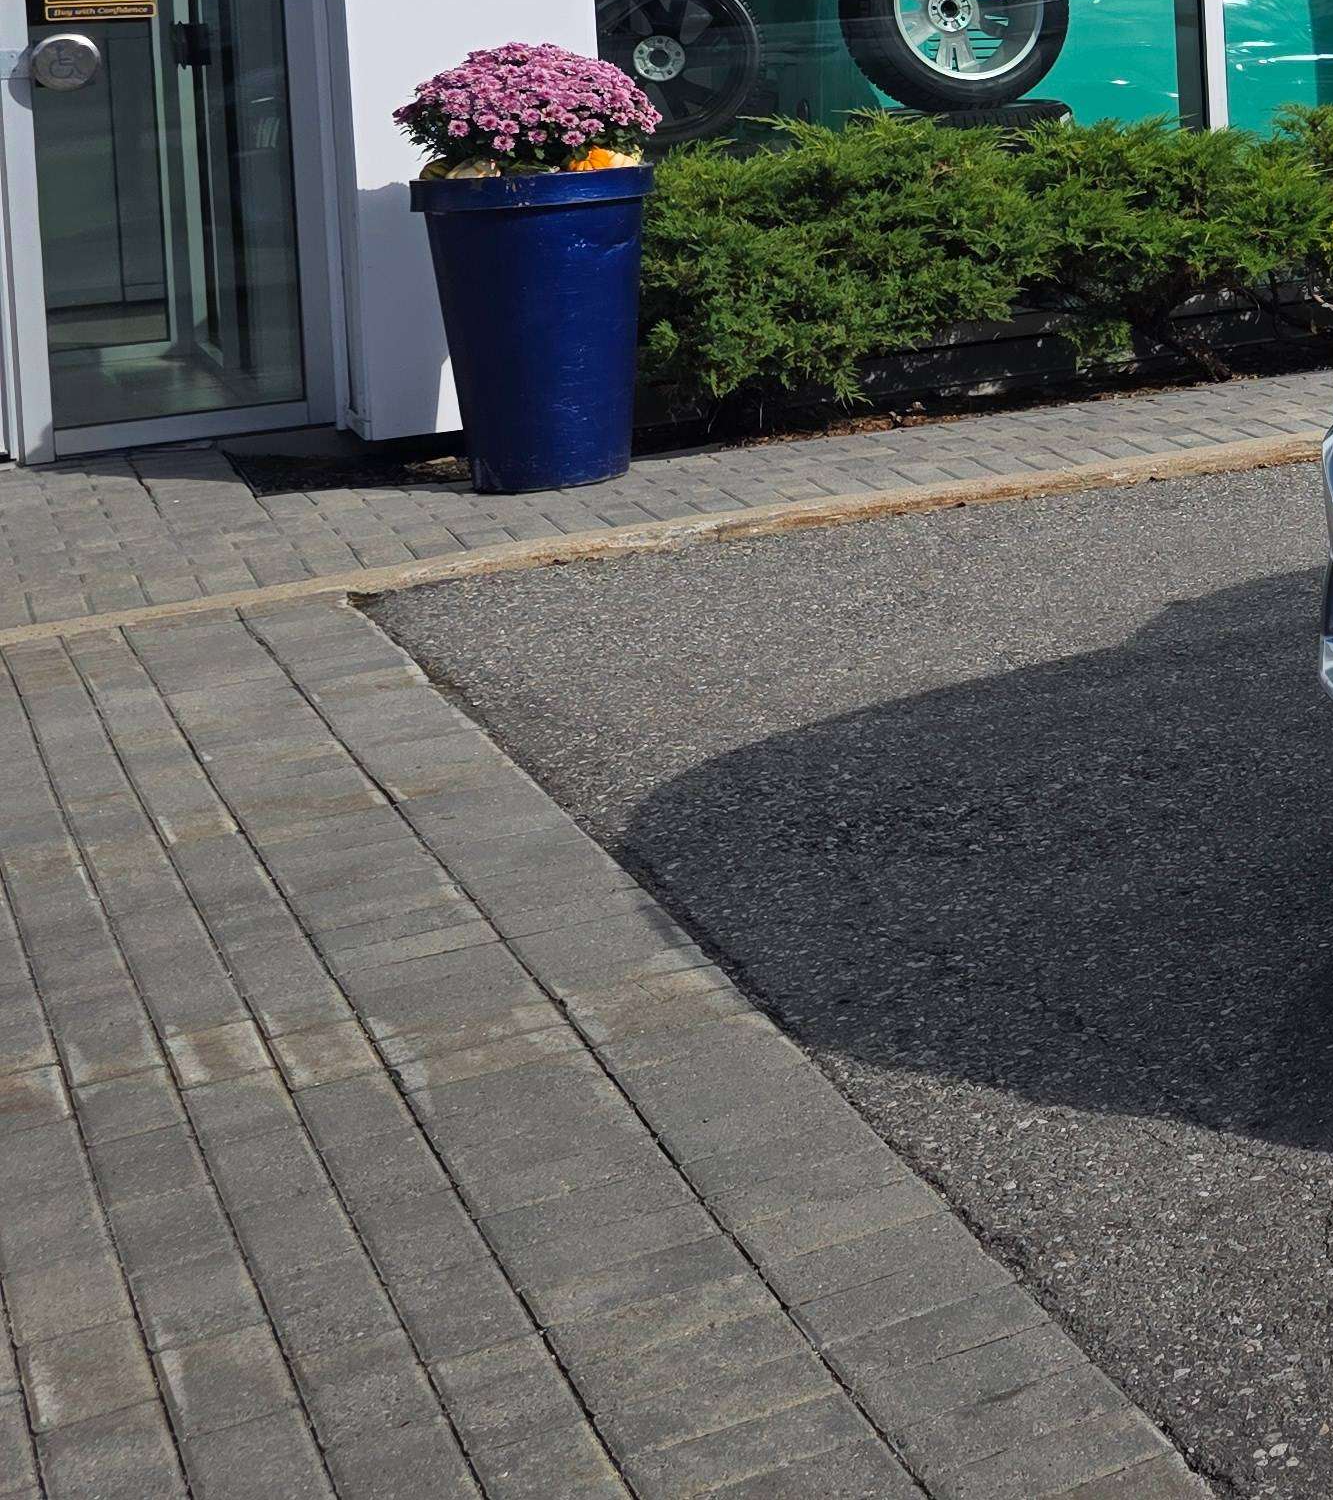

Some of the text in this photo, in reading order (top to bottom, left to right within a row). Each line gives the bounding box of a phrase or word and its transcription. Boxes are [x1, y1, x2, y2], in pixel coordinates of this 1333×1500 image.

[53, 6, 149, 17] Buy with Confidence
